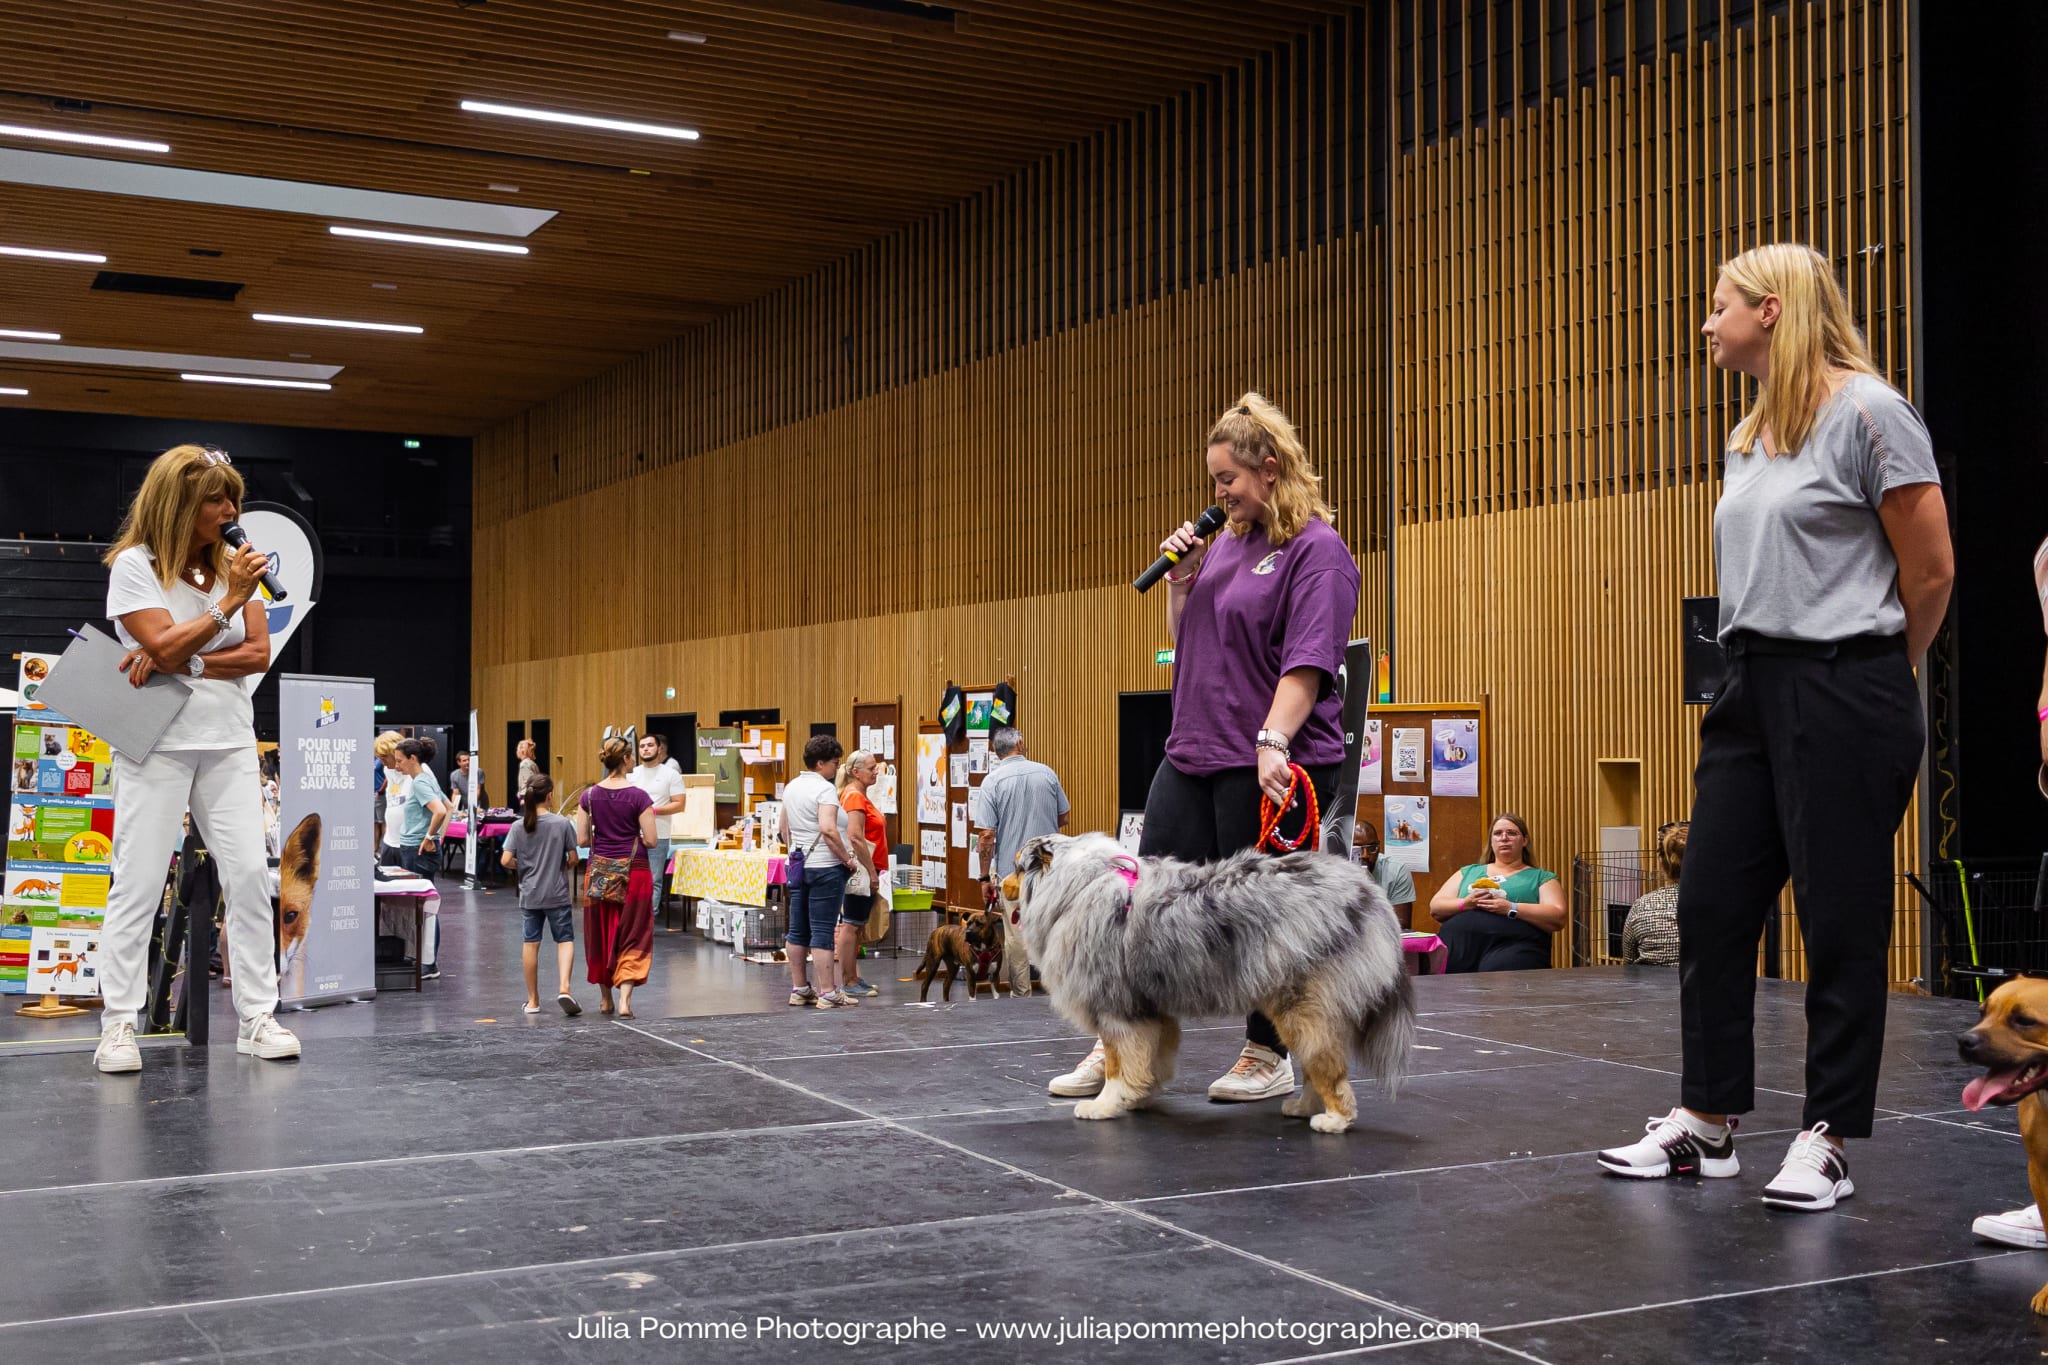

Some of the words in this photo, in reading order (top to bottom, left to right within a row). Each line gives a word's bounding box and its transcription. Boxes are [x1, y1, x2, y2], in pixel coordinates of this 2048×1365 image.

[298, 738, 331, 752] POUR
[333, 739, 357, 752] UNE
[304, 751, 351, 765] NATURE
[306, 763, 337, 777] LIBRE
[340, 764, 349, 777] &
[300, 776, 355, 790] SAUVAGE
[332, 825, 355, 837] ACTIONS
[332, 865, 356, 878] ACTIONS
[332, 904, 355, 917] ACTIONS
